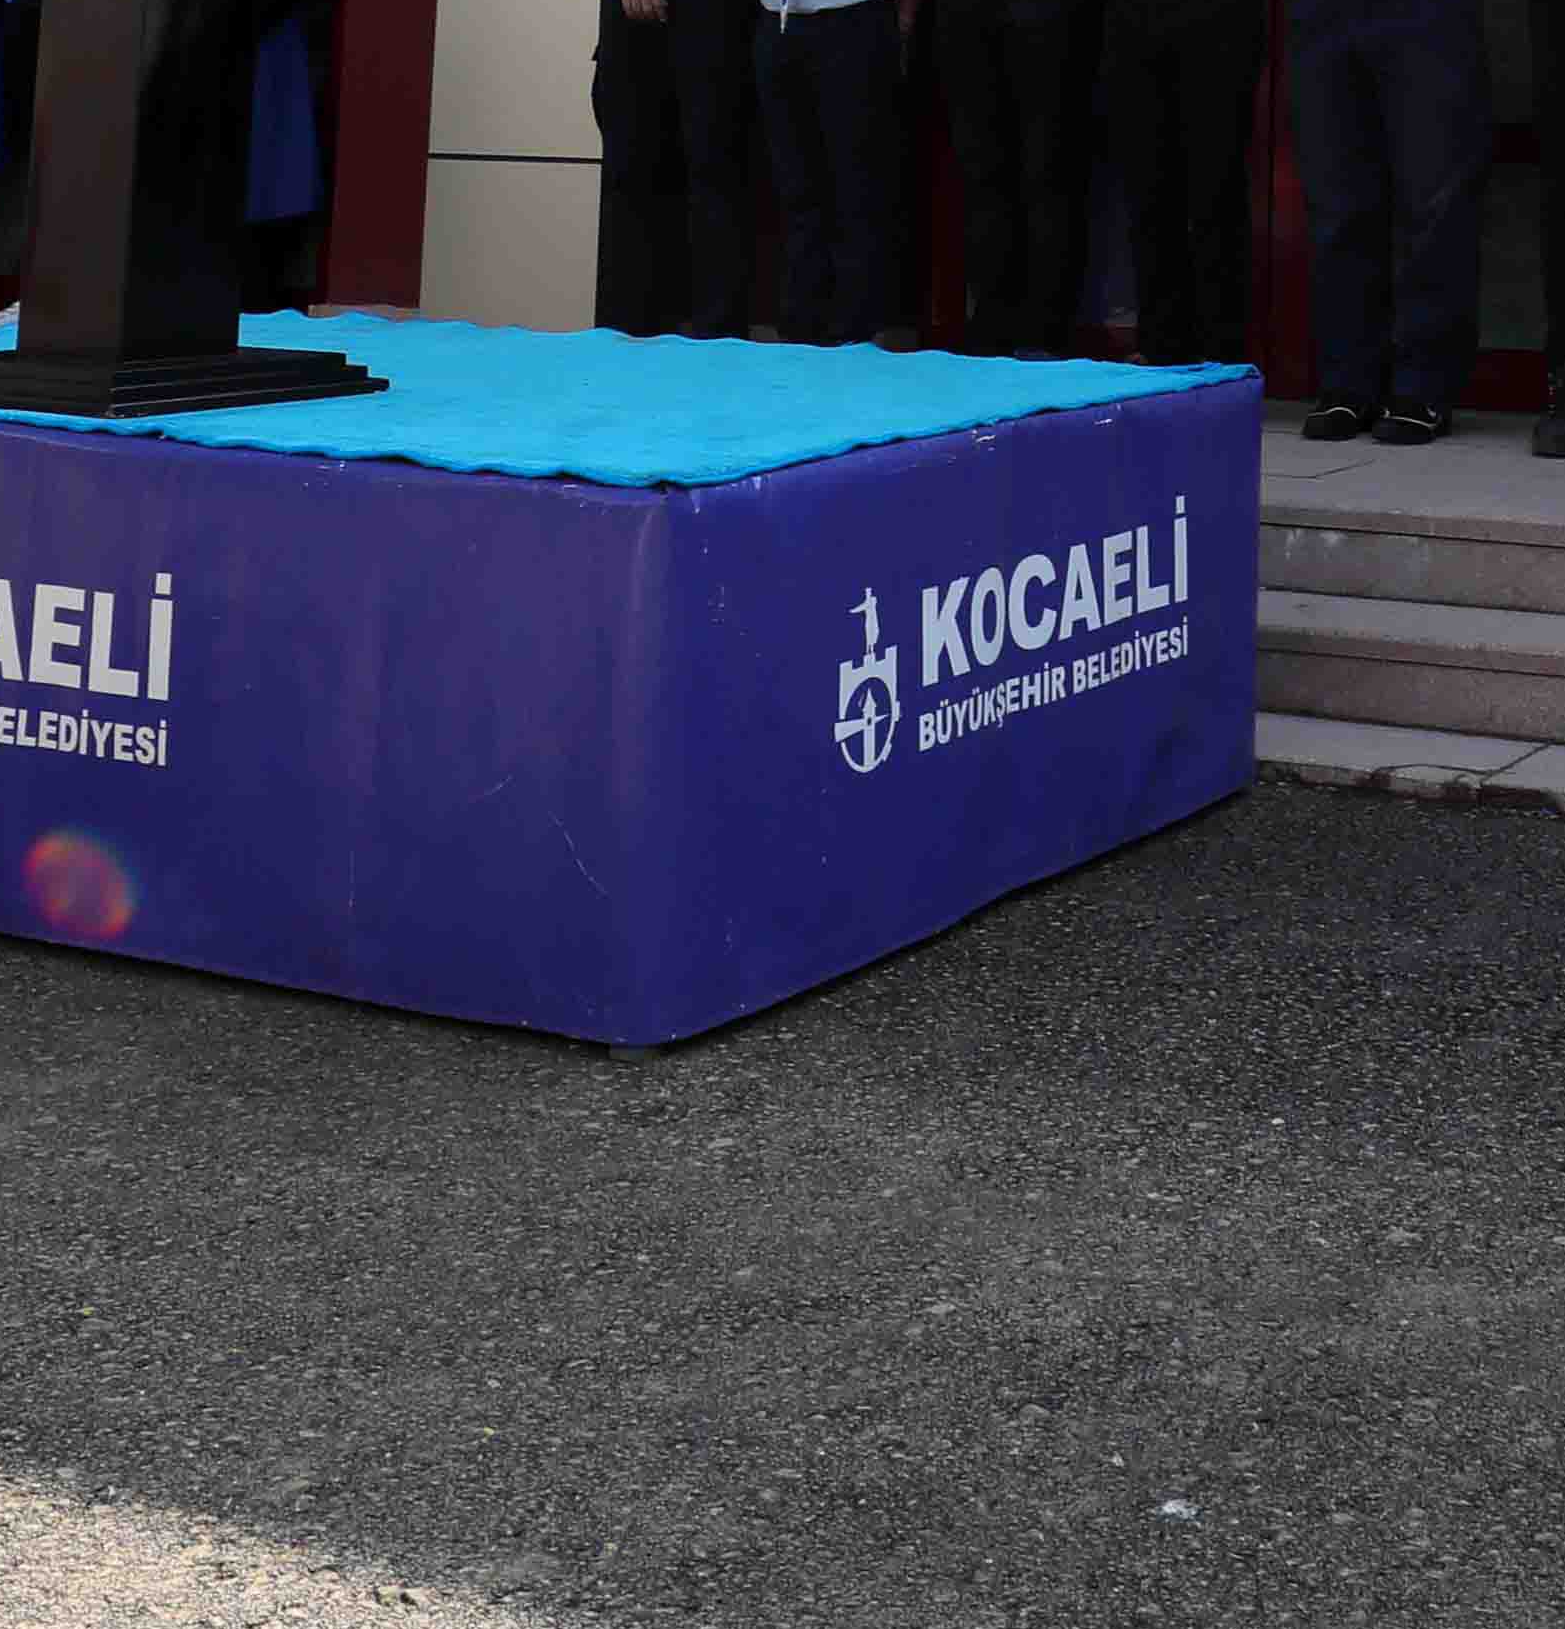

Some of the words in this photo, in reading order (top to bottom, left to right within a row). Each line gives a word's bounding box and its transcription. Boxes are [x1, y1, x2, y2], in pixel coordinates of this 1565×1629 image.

[921, 495, 1189, 688] KOCAELİ
[918, 661, 1067, 752] BÜYÜKŞEHİR
[1072, 616, 1189, 696] BELEDİYESİ
